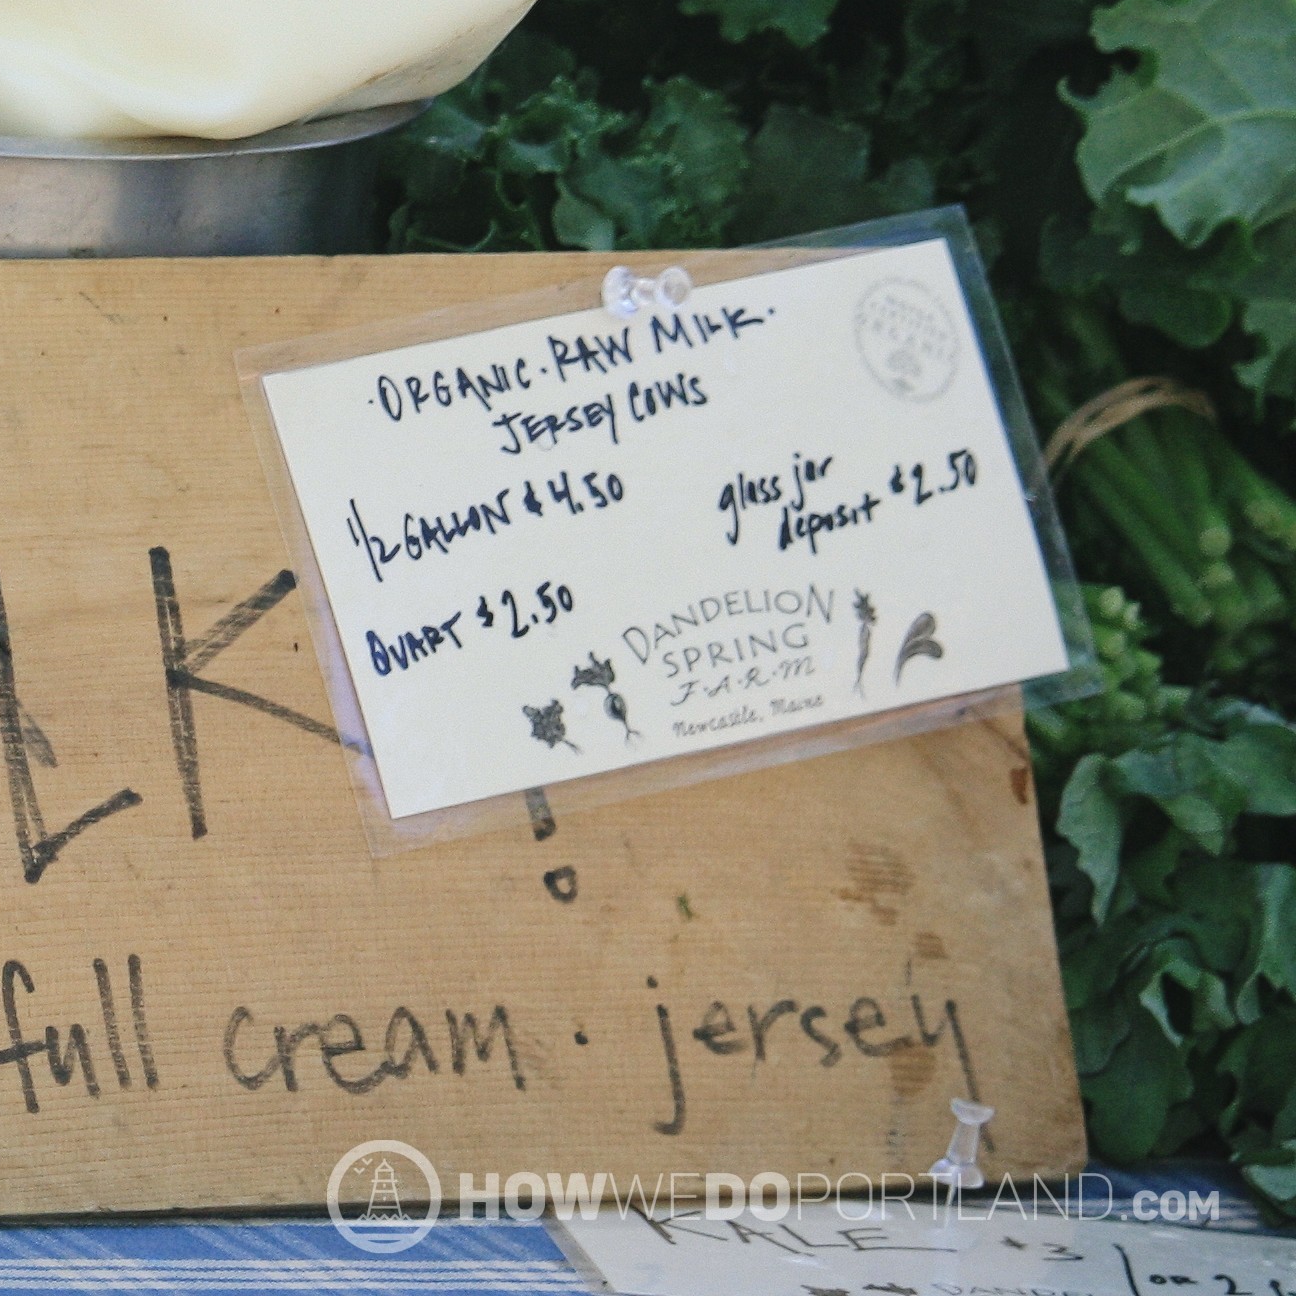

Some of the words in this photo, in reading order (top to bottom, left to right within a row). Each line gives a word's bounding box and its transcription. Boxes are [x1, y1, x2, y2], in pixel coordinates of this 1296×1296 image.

[376, 357, 531, 423] ORGANIC
[547, 326, 635, 383] RAW
[491, 393, 620, 456] JERSEY
[627, 372, 709, 424] COWS
[404, 487, 512, 561] GALLON
[718, 472, 783, 547] glass
[790, 452, 834, 512] jar
[778, 493, 881, 555] deposit
[365, 610, 463, 677] QUART
[621, 583, 835, 665] DANDELION
[662, 622, 810, 679] SPRING
[769, 694, 825, 717] Maine
[223, 1003, 528, 1096] cream
[645, 976, 995, 1153] jersey
[628, 1203, 958, 1258] KALE
